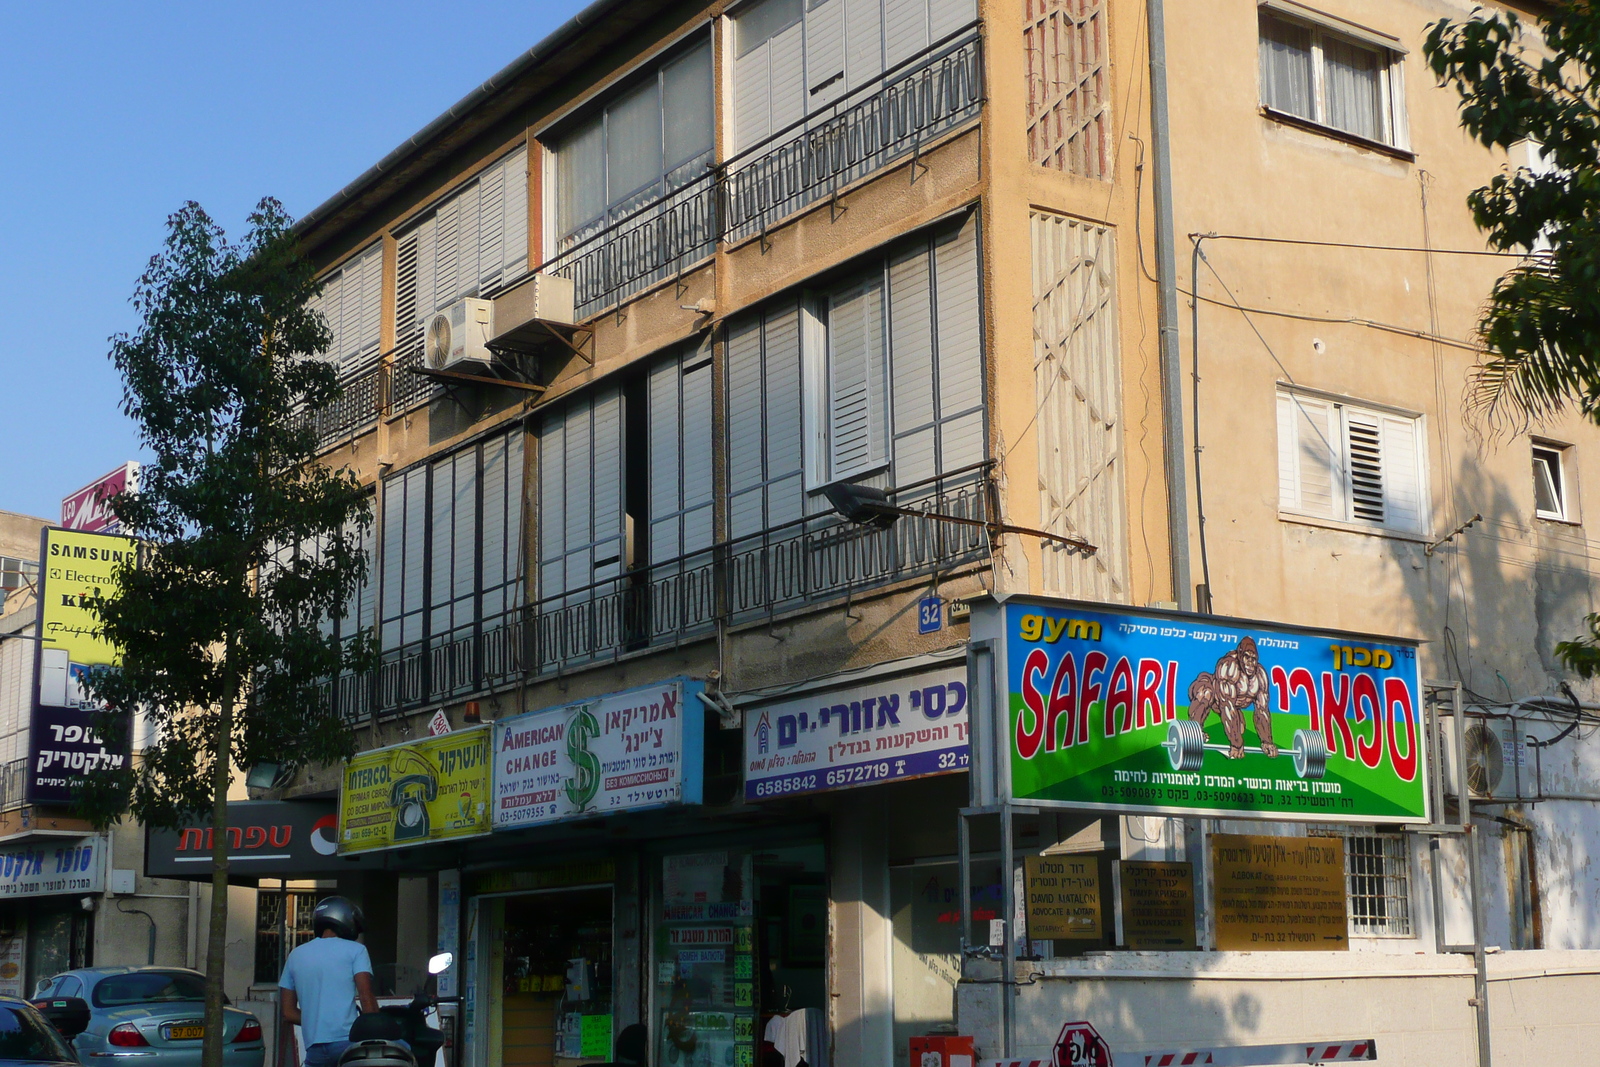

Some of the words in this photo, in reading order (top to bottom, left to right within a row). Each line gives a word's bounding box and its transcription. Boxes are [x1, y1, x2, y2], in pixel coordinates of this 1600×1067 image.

[64, 500, 76, 522] LCD
[51, 543, 135, 564] SAMSUNG
[922, 604, 938, 625] 32
[1020, 614, 1101, 645] gym
[1119, 622, 1157, 638] מסיקה
[1160, 627, 1186, 643] כלפו
[1218, 633, 1238, 648] רוני
[1257, 637, 1299, 650] בהנהלת
[1330, 644, 1394, 671] מכון
[1016, 648, 1178, 760] SAFARI
[605, 690, 678, 735] אמריקאן
[1271, 664, 1418, 783] ספארי
[502, 723, 564, 752] AMERICAN
[876, 725, 949, 757] והשקעות
[438, 743, 486, 777] אינטרקול
[506, 749, 557, 775] CHANGE
[633, 756, 647, 769] סוגי
[649, 752, 657, 767] כל
[938, 752, 958, 769] 32
[348, 764, 392, 791] INTERCOL
[537, 773, 560, 788] באישור
[756, 774, 817, 797] 6585842
[826, 762, 890, 786] 6572719
[1114, 769, 1147, 782] לחימה
[1152, 772, 1200, 786] לאומנויות
[1204, 776, 1235, 788] המרכז
[500, 781, 520, 795] ישראל
[523, 778, 534, 793] בנק
[605, 779, 618, 790] БЕЗ
[1276, 781, 1308, 793] בריאות
[1313, 782, 1341, 796] מועדון
[535, 790, 553, 804] ללא
[610, 795, 621, 805] 32
[628, 787, 675, 802] רוטשילד
[1101, 786, 1163, 800] 03-5090893
[1168, 789, 1188, 802] פקס
[505, 794, 532, 808] עמלות
[1296, 794, 1335, 807] רוטשילד
[500, 806, 545, 823] 03-5079355
[175, 825, 294, 852] טפרות
[55, 845, 93, 874] סופר
[1322, 846, 1337, 865] אשר
[1039, 861, 1064, 874] מטלון
[1068, 863, 1085, 874] דוד
[1160, 867, 1187, 878] טימור
[1030, 877, 1058, 888] ונוטריון
[1231, 871, 1262, 880] АДВОКАТ
[20, 881, 40, 893] חשמל
[43, 878, 67, 892] למוצרי
[69, 878, 91, 890] המרכז
[1061, 877, 1095, 889] עורך-דין
[1031, 893, 1055, 904] DAVID
[1058, 893, 1096, 904] MATALON
[1129, 888, 1153, 897] ТИМУР
[1032, 907, 1064, 916] ADVOCATE
[1066, 908, 1071, 916] &
[1073, 907, 1096, 916] NOTARY
[1034, 925, 1065, 933] НОТАРИУС
[1136, 919, 1184, 927] ADVOCATE
[682, 929, 705, 943] מטבע
[708, 928, 732, 943] המרת
[1277, 932, 1286, 942] 32
[1287, 931, 1316, 943] רוטשילד
